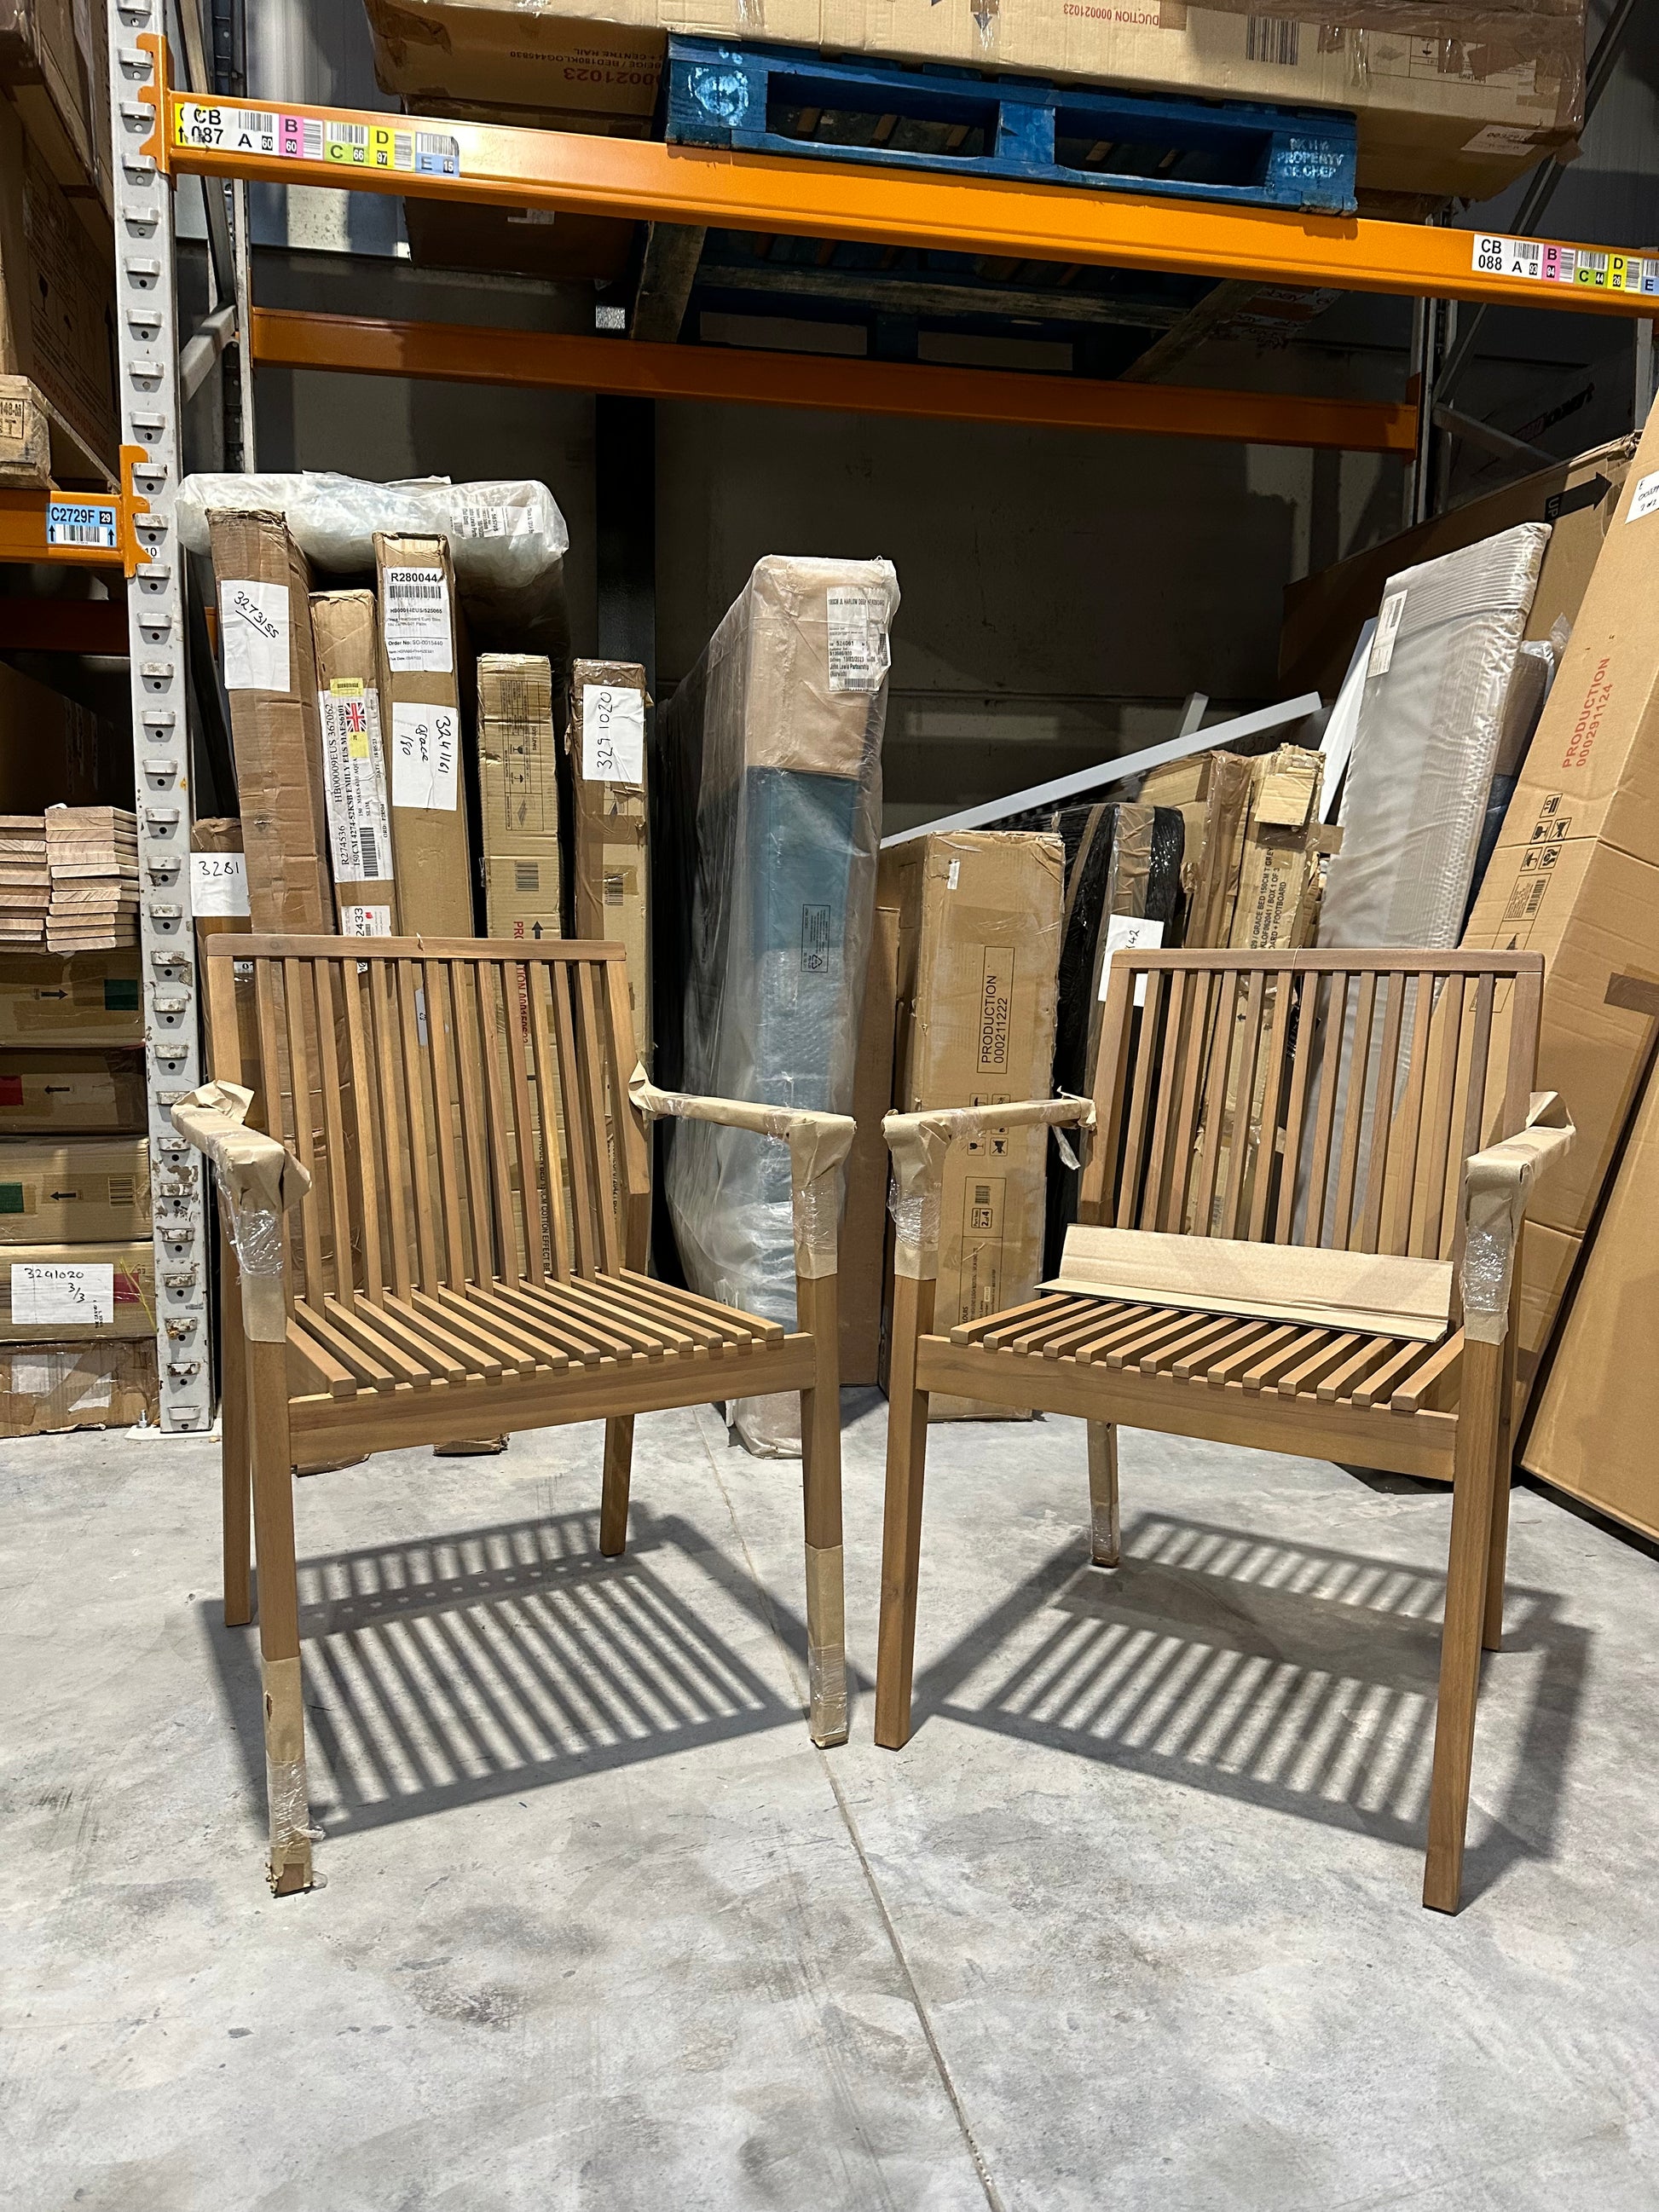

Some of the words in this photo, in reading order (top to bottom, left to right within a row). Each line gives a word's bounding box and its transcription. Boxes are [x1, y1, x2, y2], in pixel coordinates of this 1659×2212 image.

[194, 107, 222, 125] CB
[285, 118, 298, 132] B
[238, 134, 252, 147] A
[263, 136, 273, 150] 60
[286, 140, 297, 153] 60
[376, 130, 389, 144] D
[330, 145, 344, 159] C
[353, 148, 364, 161] 66
[421, 157, 433, 170] E
[443, 160, 454, 172] 15
[1481, 239, 1502, 254] CB
[1547, 248, 1558, 260] B
[1478, 254, 1502, 270] 088
[1512, 261, 1523, 273] A
[1614, 257, 1623, 269] D
[1579, 269, 1589, 282] C
[1645, 280, 1654, 291] E
[51, 506, 95, 523] C2729F
[101, 512, 111, 523] 29
[1548, 496, 1559, 517] UP
[390, 572, 437, 582] R280044
[325, 703, 336, 737] 367062
[1562, 658, 1610, 768] PRODUCTION
[338, 705, 347, 745] MAES6101
[597, 691, 612, 769] 3291020
[1575, 684, 1613, 767] 000291124
[330, 739, 343, 802] HB00009EUS
[343, 766, 352, 793] EMILY
[338, 825, 350, 866] R274536
[351, 840, 361, 866] 150CM
[1264, 846, 1275, 866] GREY
[1259, 874, 1270, 894] 150CM
[1271, 873, 1279, 882] OF
[1256, 896, 1265, 910] BED
[1268, 890, 1276, 904] BOX
[1273, 881, 1286, 924] FOOTBOARD
[355, 908, 365, 936] 2433
[1253, 912, 1263, 935] GRACE
[981, 974, 997, 1064] PRODUCTION
[993, 997, 1009, 1064] 000211222
[542, 1235, 551, 1260] EFFECT
